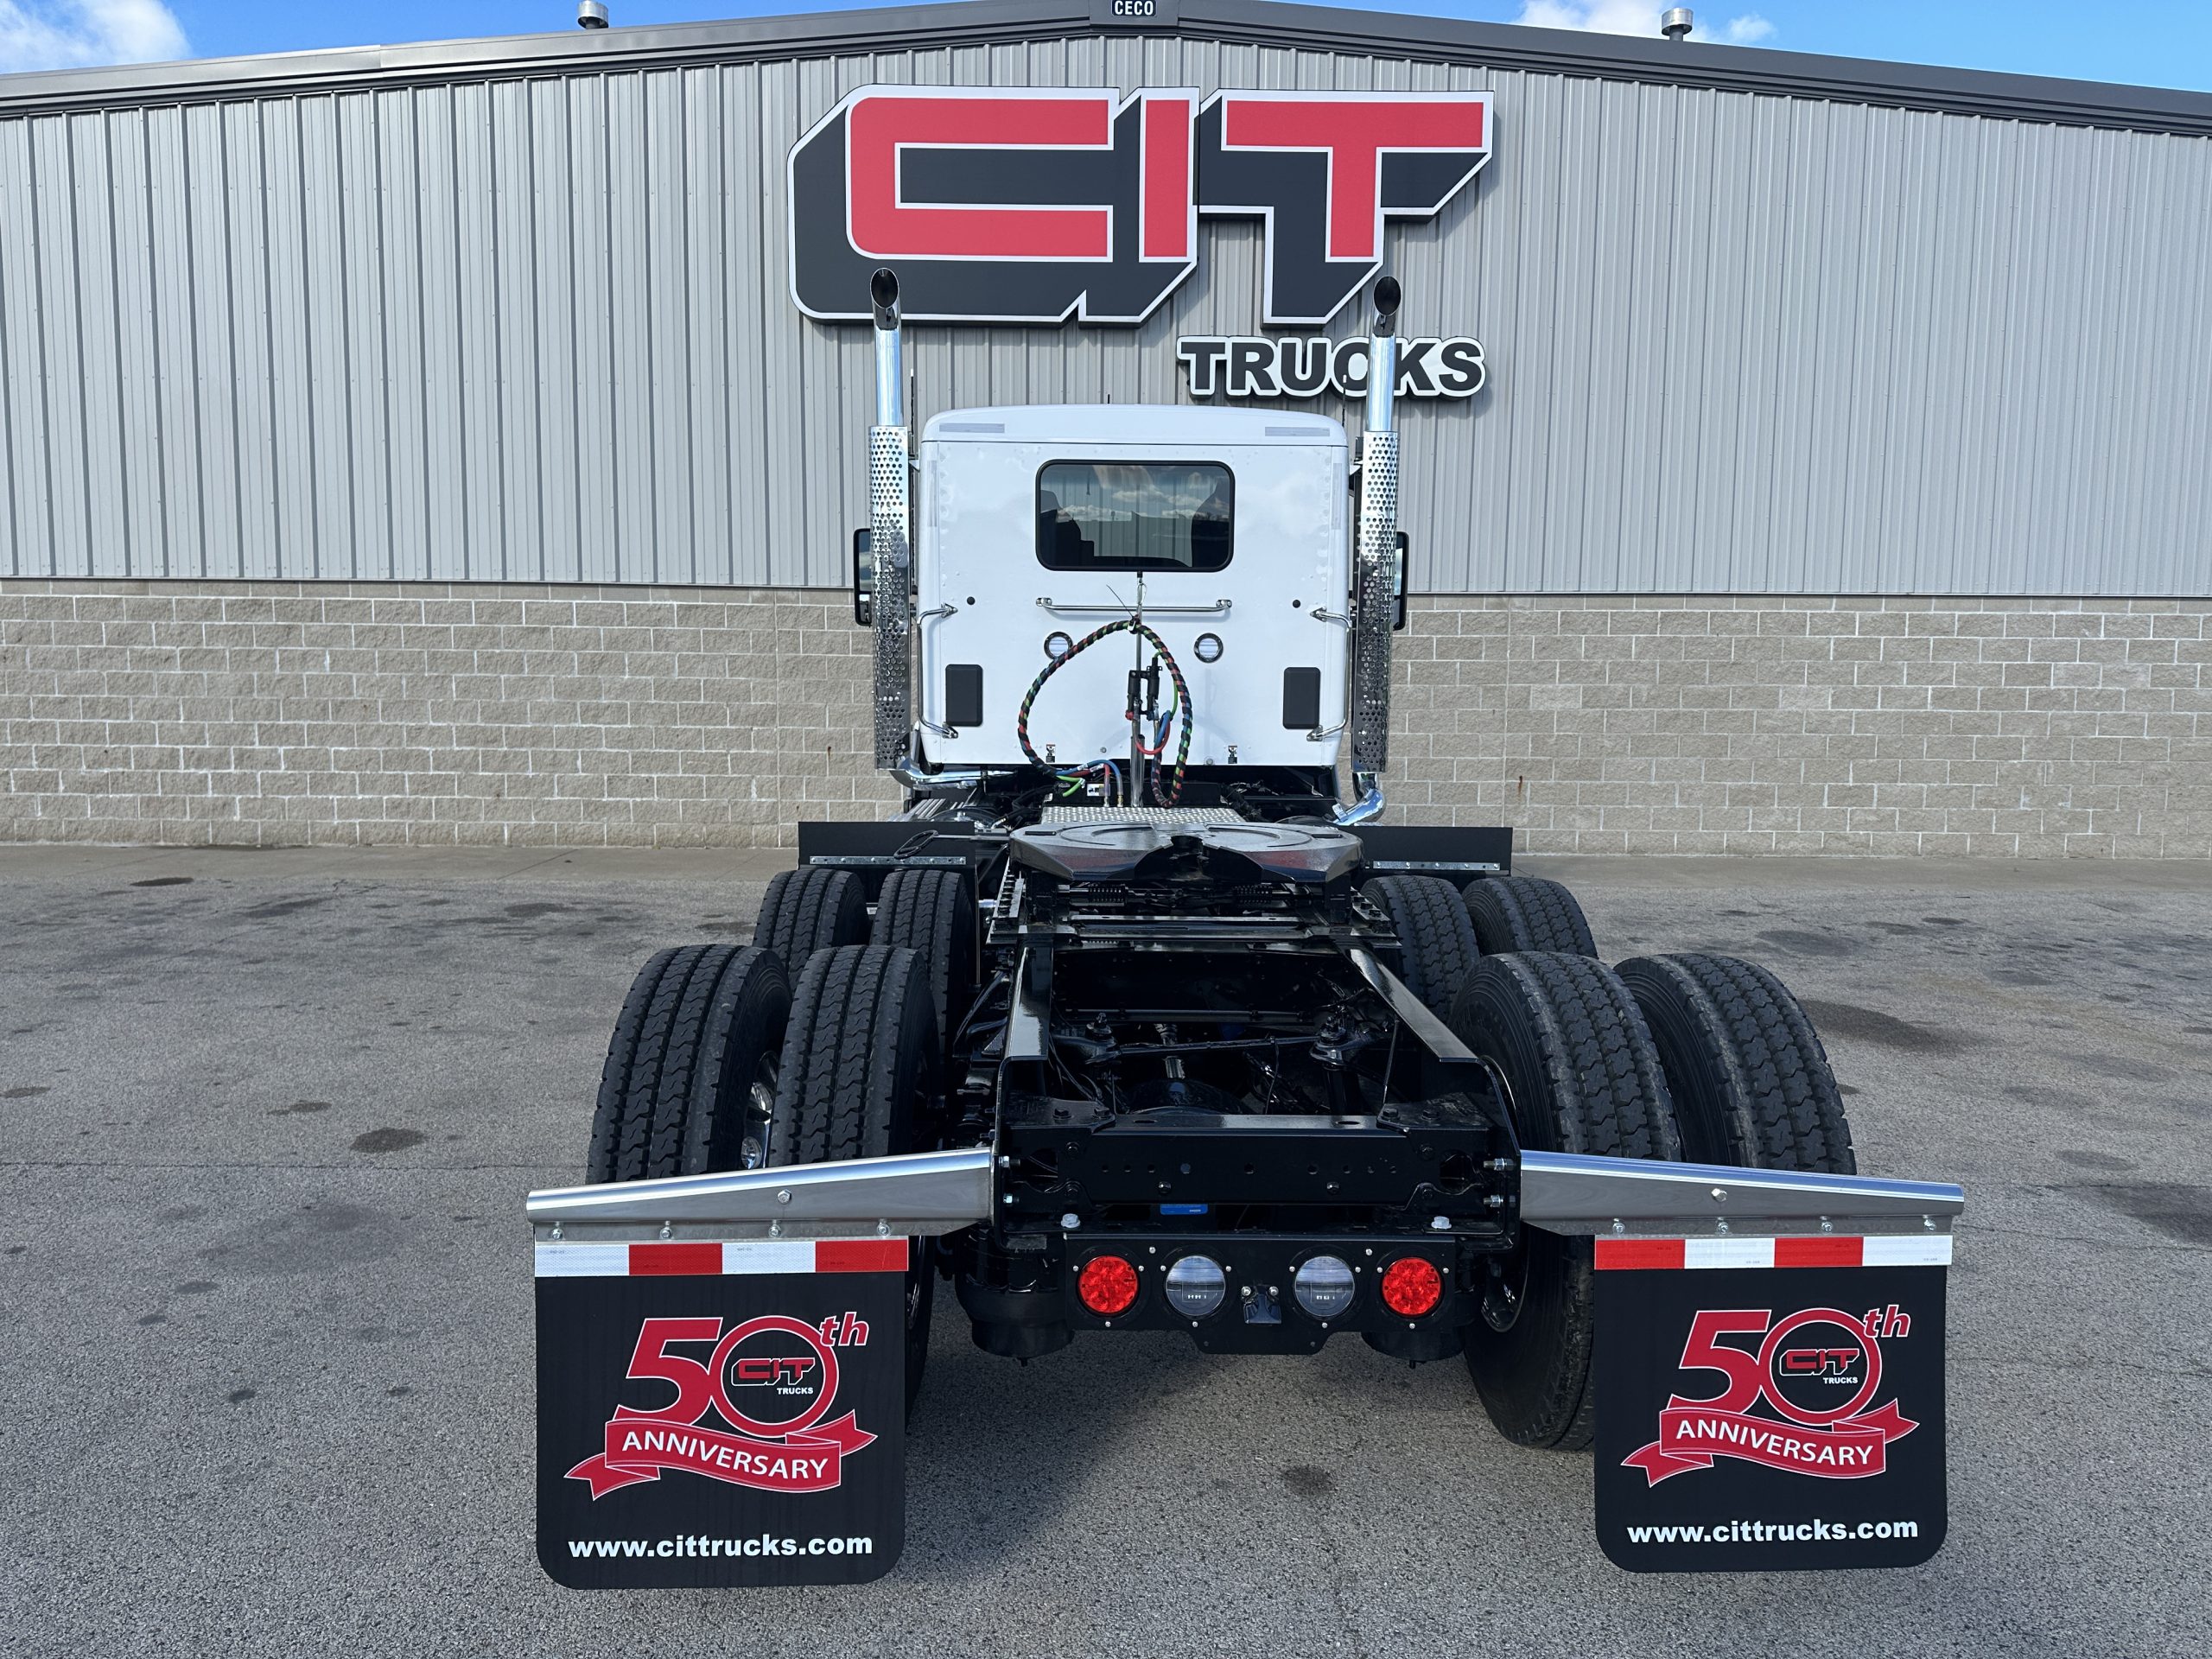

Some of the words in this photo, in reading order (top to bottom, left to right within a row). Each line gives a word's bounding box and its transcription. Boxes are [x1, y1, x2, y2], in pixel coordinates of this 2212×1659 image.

[1114, 0, 1154, 16] CECO
[838, 84, 1495, 273] CIT
[1179, 340, 1484, 392] TRUCKS
[732, 1357, 816, 1386] CIT
[1780, 1348, 1859, 1376] CIT
[776, 1387, 814, 1395] TRUCKS
[1822, 1376, 1859, 1385] TRUCKS
[621, 1430, 830, 1480] ANNIVERSARY
[1675, 1419, 1874, 1466] ANNIVERSARY
[1626, 1518, 1918, 1544] www.cittrucks.com
[568, 1535, 874, 1559] www.cittrucks.com
